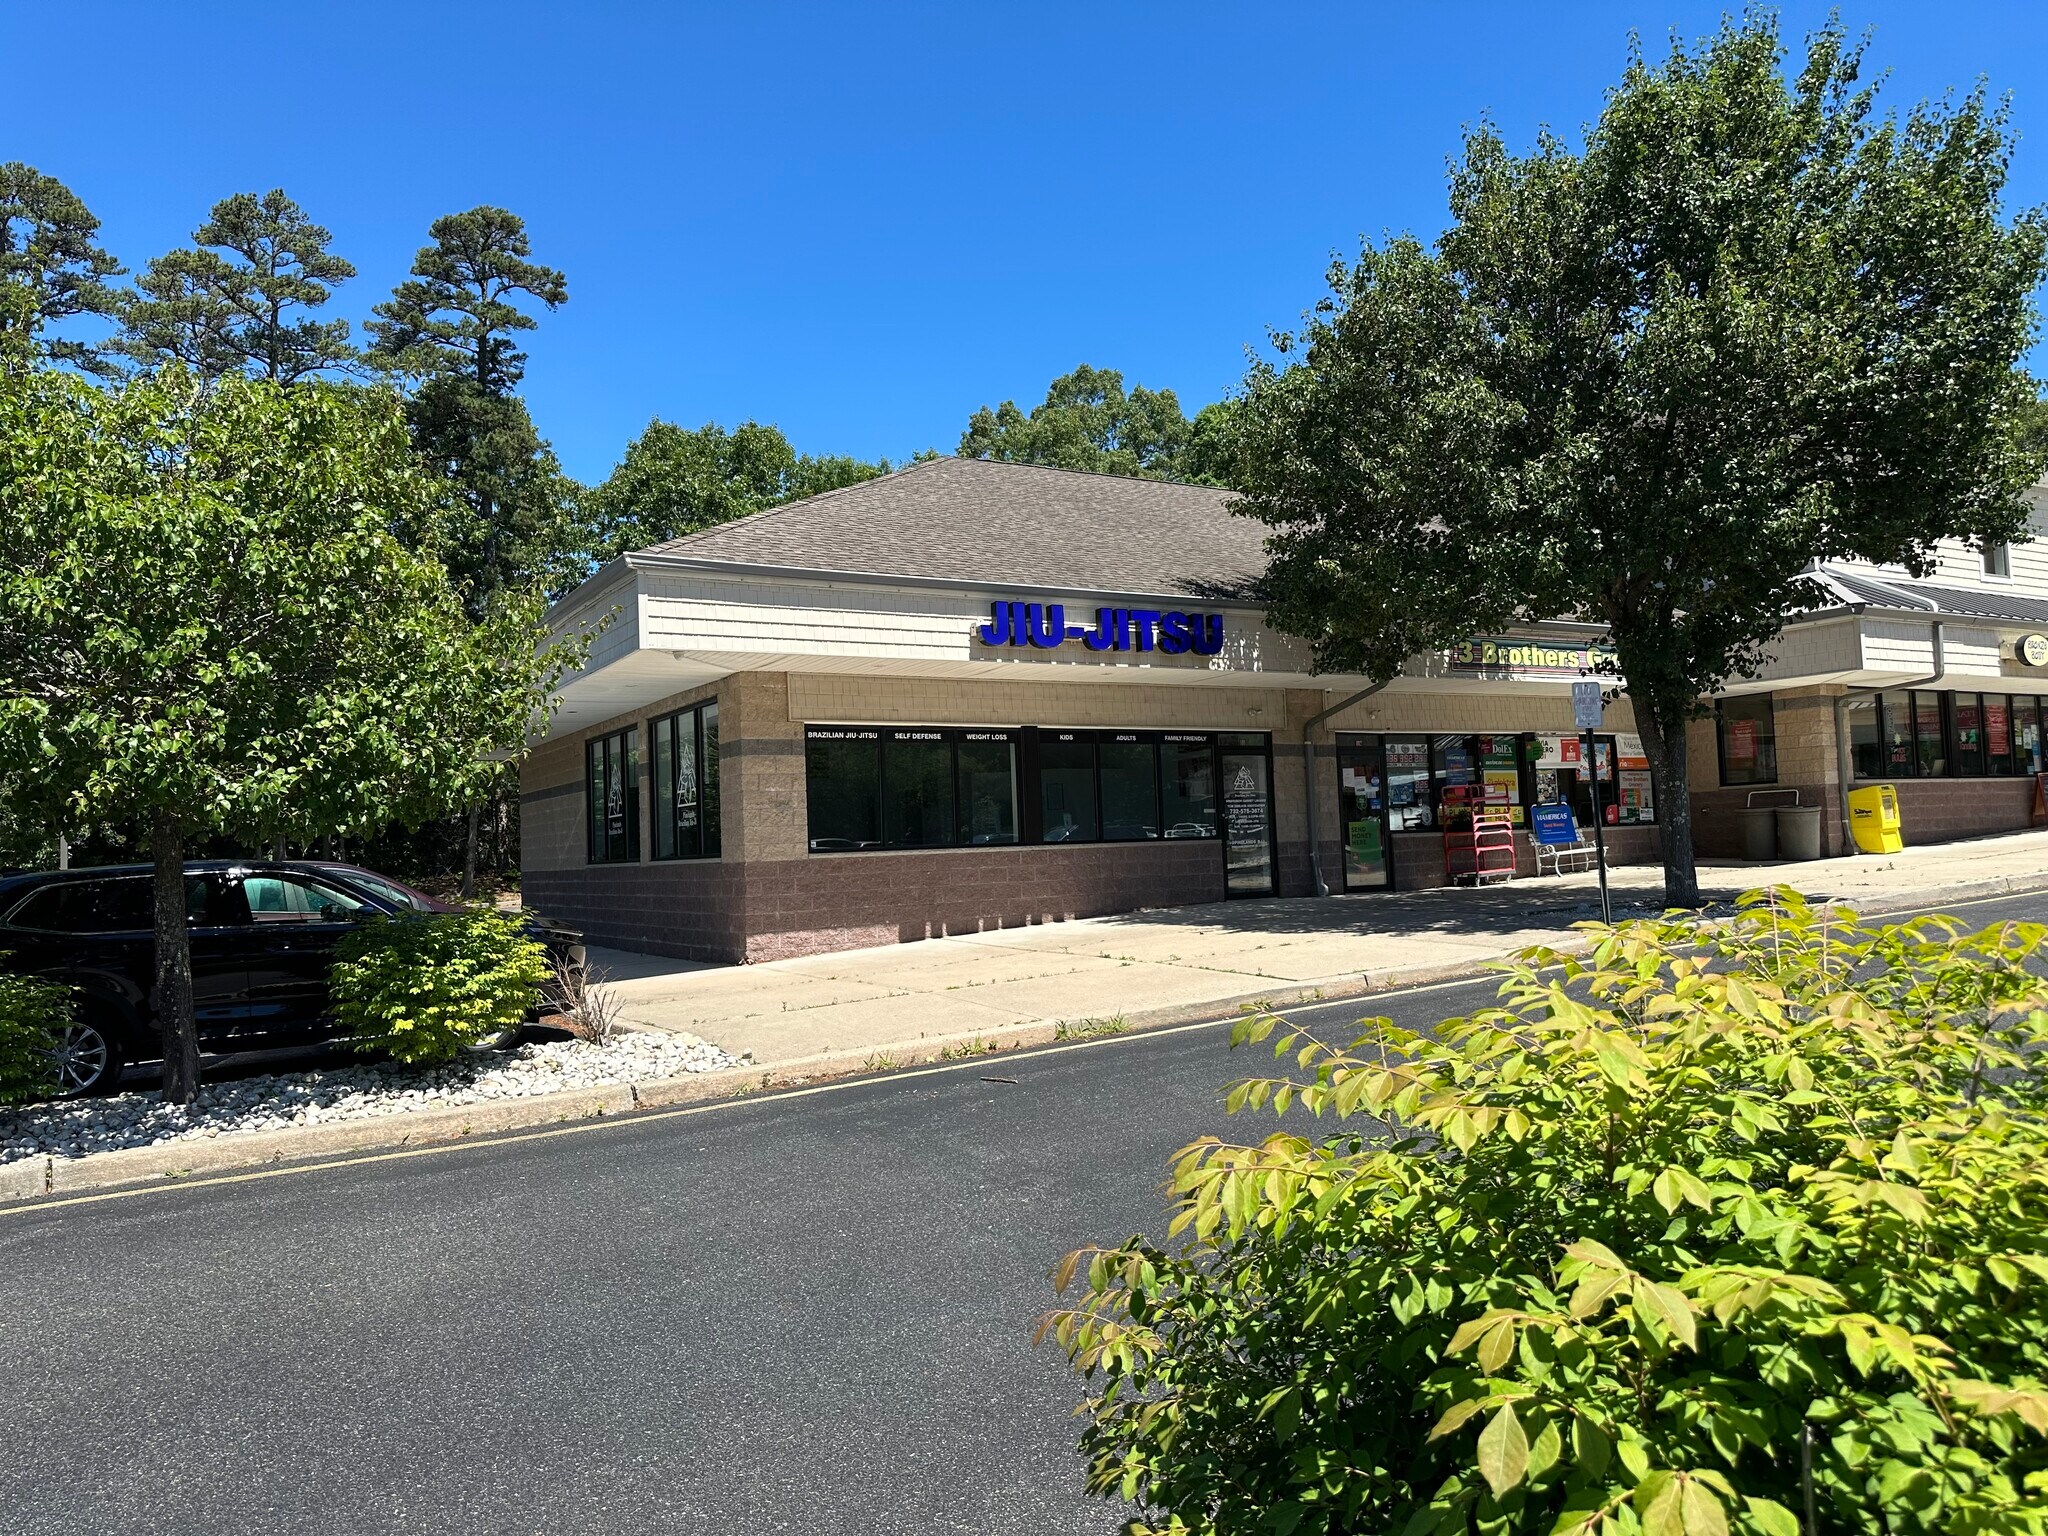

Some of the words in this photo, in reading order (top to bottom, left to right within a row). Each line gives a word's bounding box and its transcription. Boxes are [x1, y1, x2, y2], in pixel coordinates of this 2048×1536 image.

[979, 600, 1223, 655] JIU-JITSU
[1458, 640, 1474, 664] 3
[1481, 641, 1580, 668] Brothers
[1575, 697, 1599, 706] PARKING
[807, 731, 844, 739] BRAZILIAN
[1492, 744, 1513, 753] DolEx
[1536, 812, 1568, 821] VIAMERICAS
